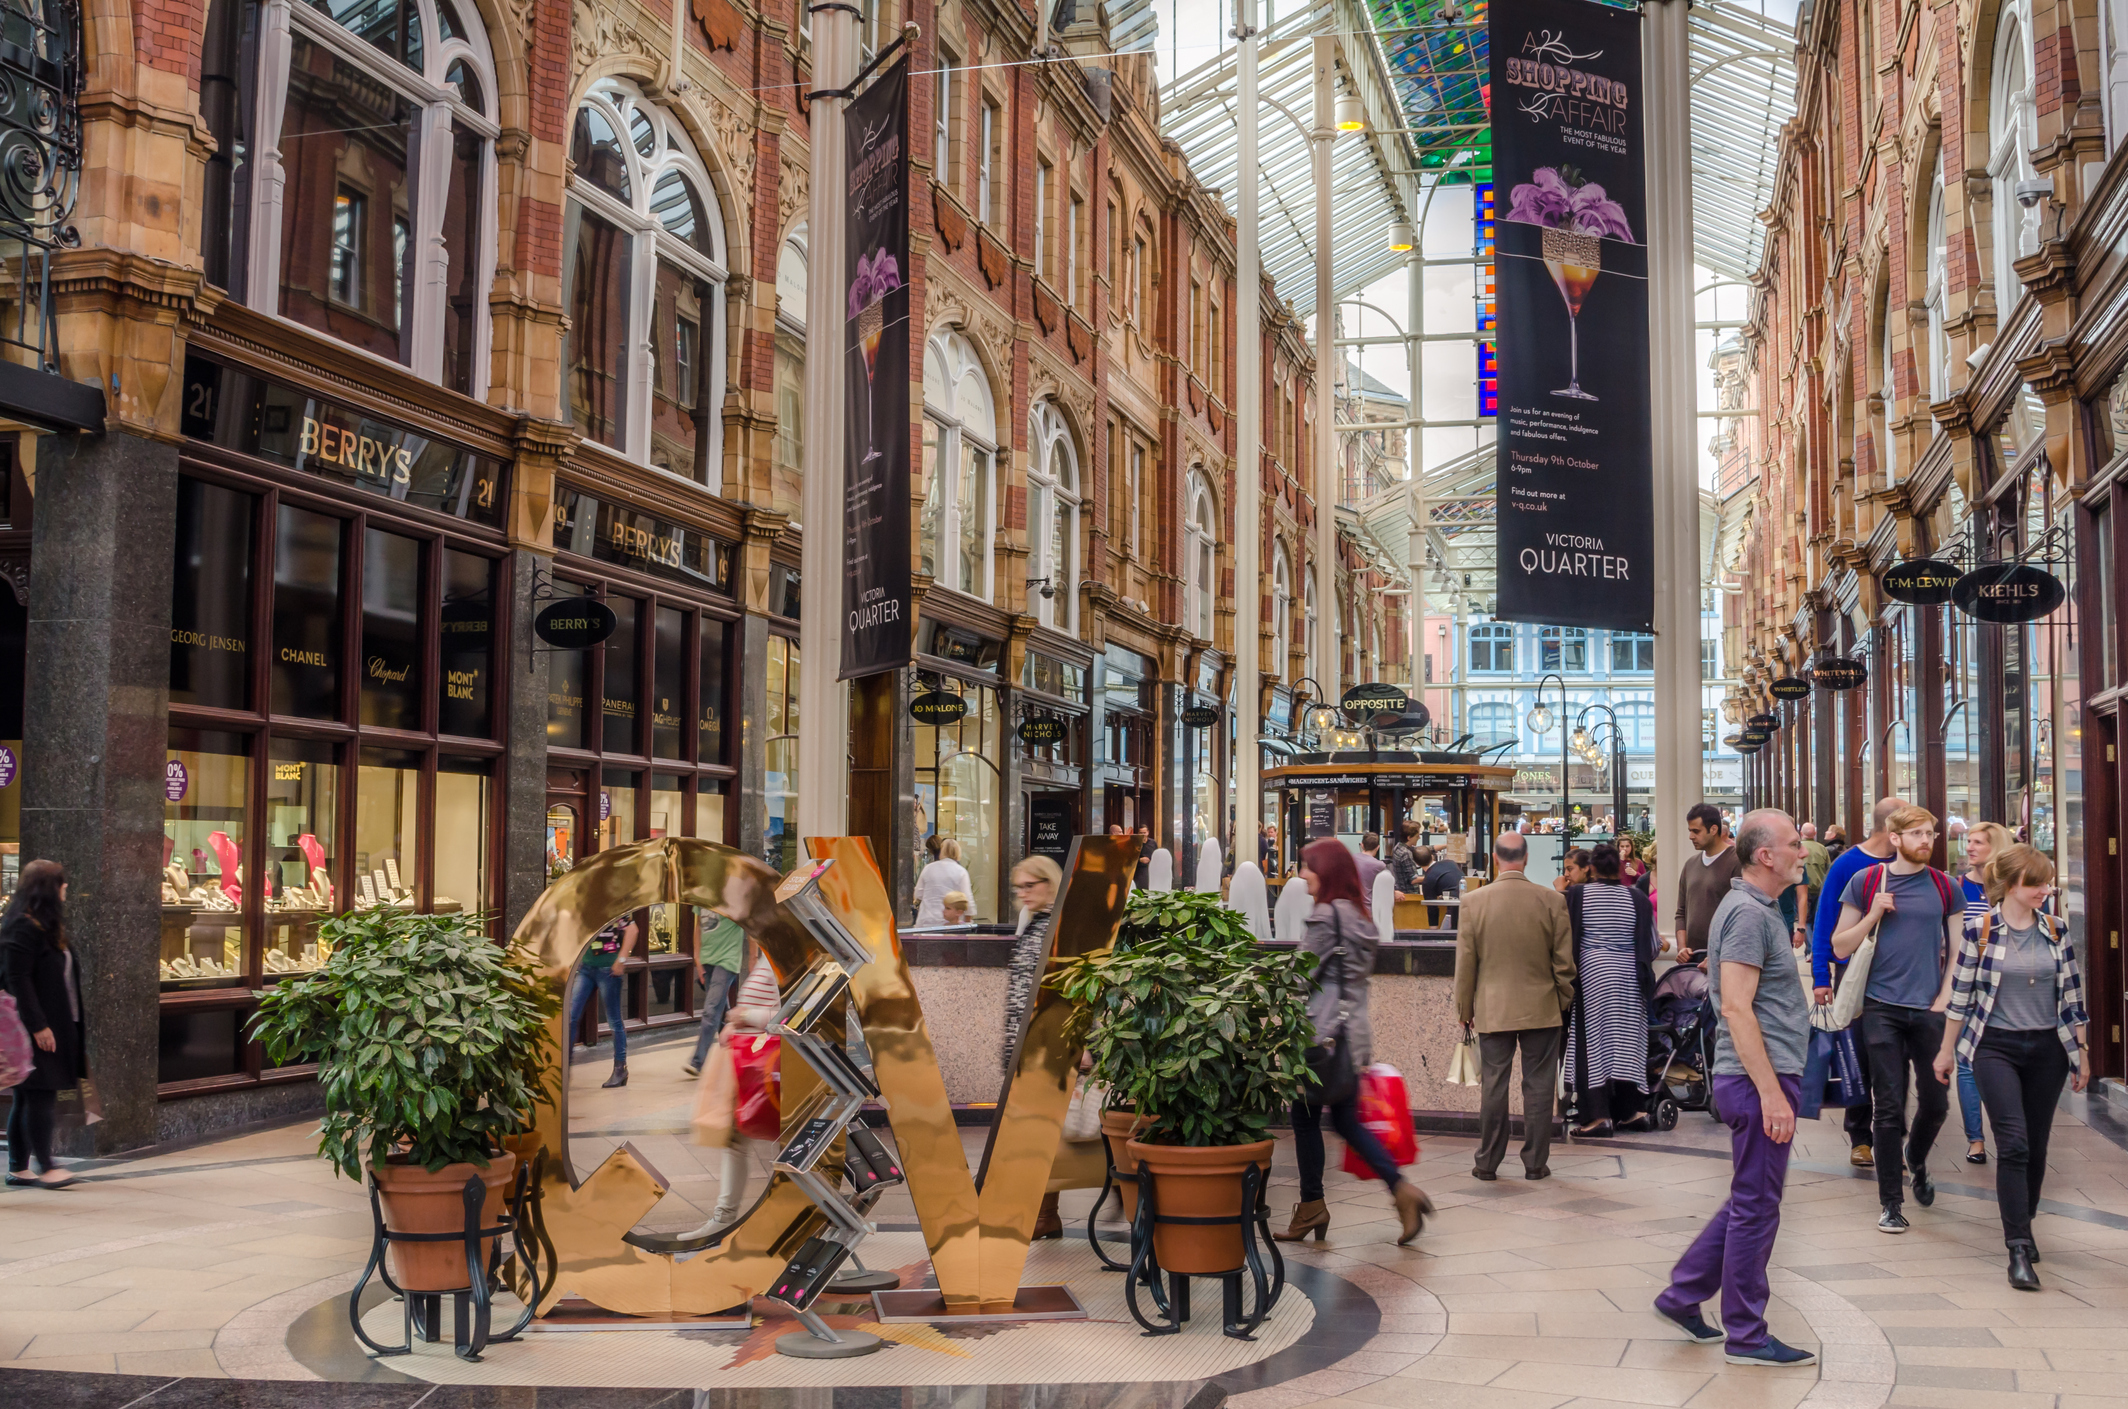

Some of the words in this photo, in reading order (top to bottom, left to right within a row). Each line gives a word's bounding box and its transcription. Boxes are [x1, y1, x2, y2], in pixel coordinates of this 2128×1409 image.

[1521, 31, 1540, 55] A
[1506, 56, 1628, 110] SHOPPING
[1550, 97, 1626, 135] AFFAIR
[1560, 126, 1573, 135] THE
[1574, 129, 1593, 139] MOST
[1594, 130, 1626, 146] FABULOUS
[1563, 135, 1585, 146] EVENT
[1585, 139, 1596, 148] OF
[1597, 141, 1609, 151] THE
[1610, 143, 1627, 155] YEAR
[849, 133, 899, 197] SHOPPING
[865, 162, 899, 208] AFFAIR
[784, 274, 807, 295] MALON
[189, 382, 212, 419] 21
[1510, 405, 1522, 414] Join
[1532, 407, 1541, 416] for
[1551, 411, 1573, 421] evening
[1574, 413, 1580, 421] of
[1510, 418, 1528, 427] music,
[1529, 419, 1568, 431] performance,
[1569, 424, 1599, 435] indulgence
[1510, 429, 1521, 437] and
[1521, 430, 1548, 440] fabulous
[1549, 433, 1568, 442] offers.
[300, 416, 412, 484] BERRY'S
[1511, 450, 1549, 466] Thursday
[1550, 455, 1565, 466] 9th
[1566, 457, 1599, 470] October
[1510, 464, 1532, 475] 6-9pm
[477, 478, 493, 508] 21
[1511, 486, 1526, 496] Find
[1526, 490, 1539, 498] out
[1539, 490, 1558, 499] more
[1559, 492, 1566, 500] at
[1511, 501, 1548, 512] v-q.co.uk
[1546, 532, 1604, 551] VICTORIA
[1519, 547, 1629, 581] QUARTER
[860, 586, 886, 603] VICTORIA
[1978, 584, 2039, 598] KIEHL'S
[550, 618, 600, 630] BERRY'S
[849, 599, 900, 635] QUARTER
[171, 629, 206, 647] GEORG
[209, 635, 245, 653] JENSEN
[281, 647, 327, 667] CHANEL
[368, 655, 410, 685] Chopard
[448, 670, 474, 686] MONT
[447, 684, 474, 700] BLANC
[602, 698, 635, 712] PANERAI
[913, 704, 924, 713] JO
[925, 703, 964, 712] MALONE
[1344, 698, 1405, 710] OPPOSITE
[700, 719, 721, 732] OMEGA
[1025, 723, 1059, 731] HARVEY
[1023, 730, 1062, 738] NICHOLS
[167, 763, 183, 778] 0%
[275, 764, 301, 772] MONT
[275, 772, 301, 780] BLANC
[1516, 769, 1551, 783] JONES
[1329, 776, 1368, 784] SANDWICHES
[1039, 822, 1057, 831] TAKE
[1036, 832, 1059, 840] AWAY
